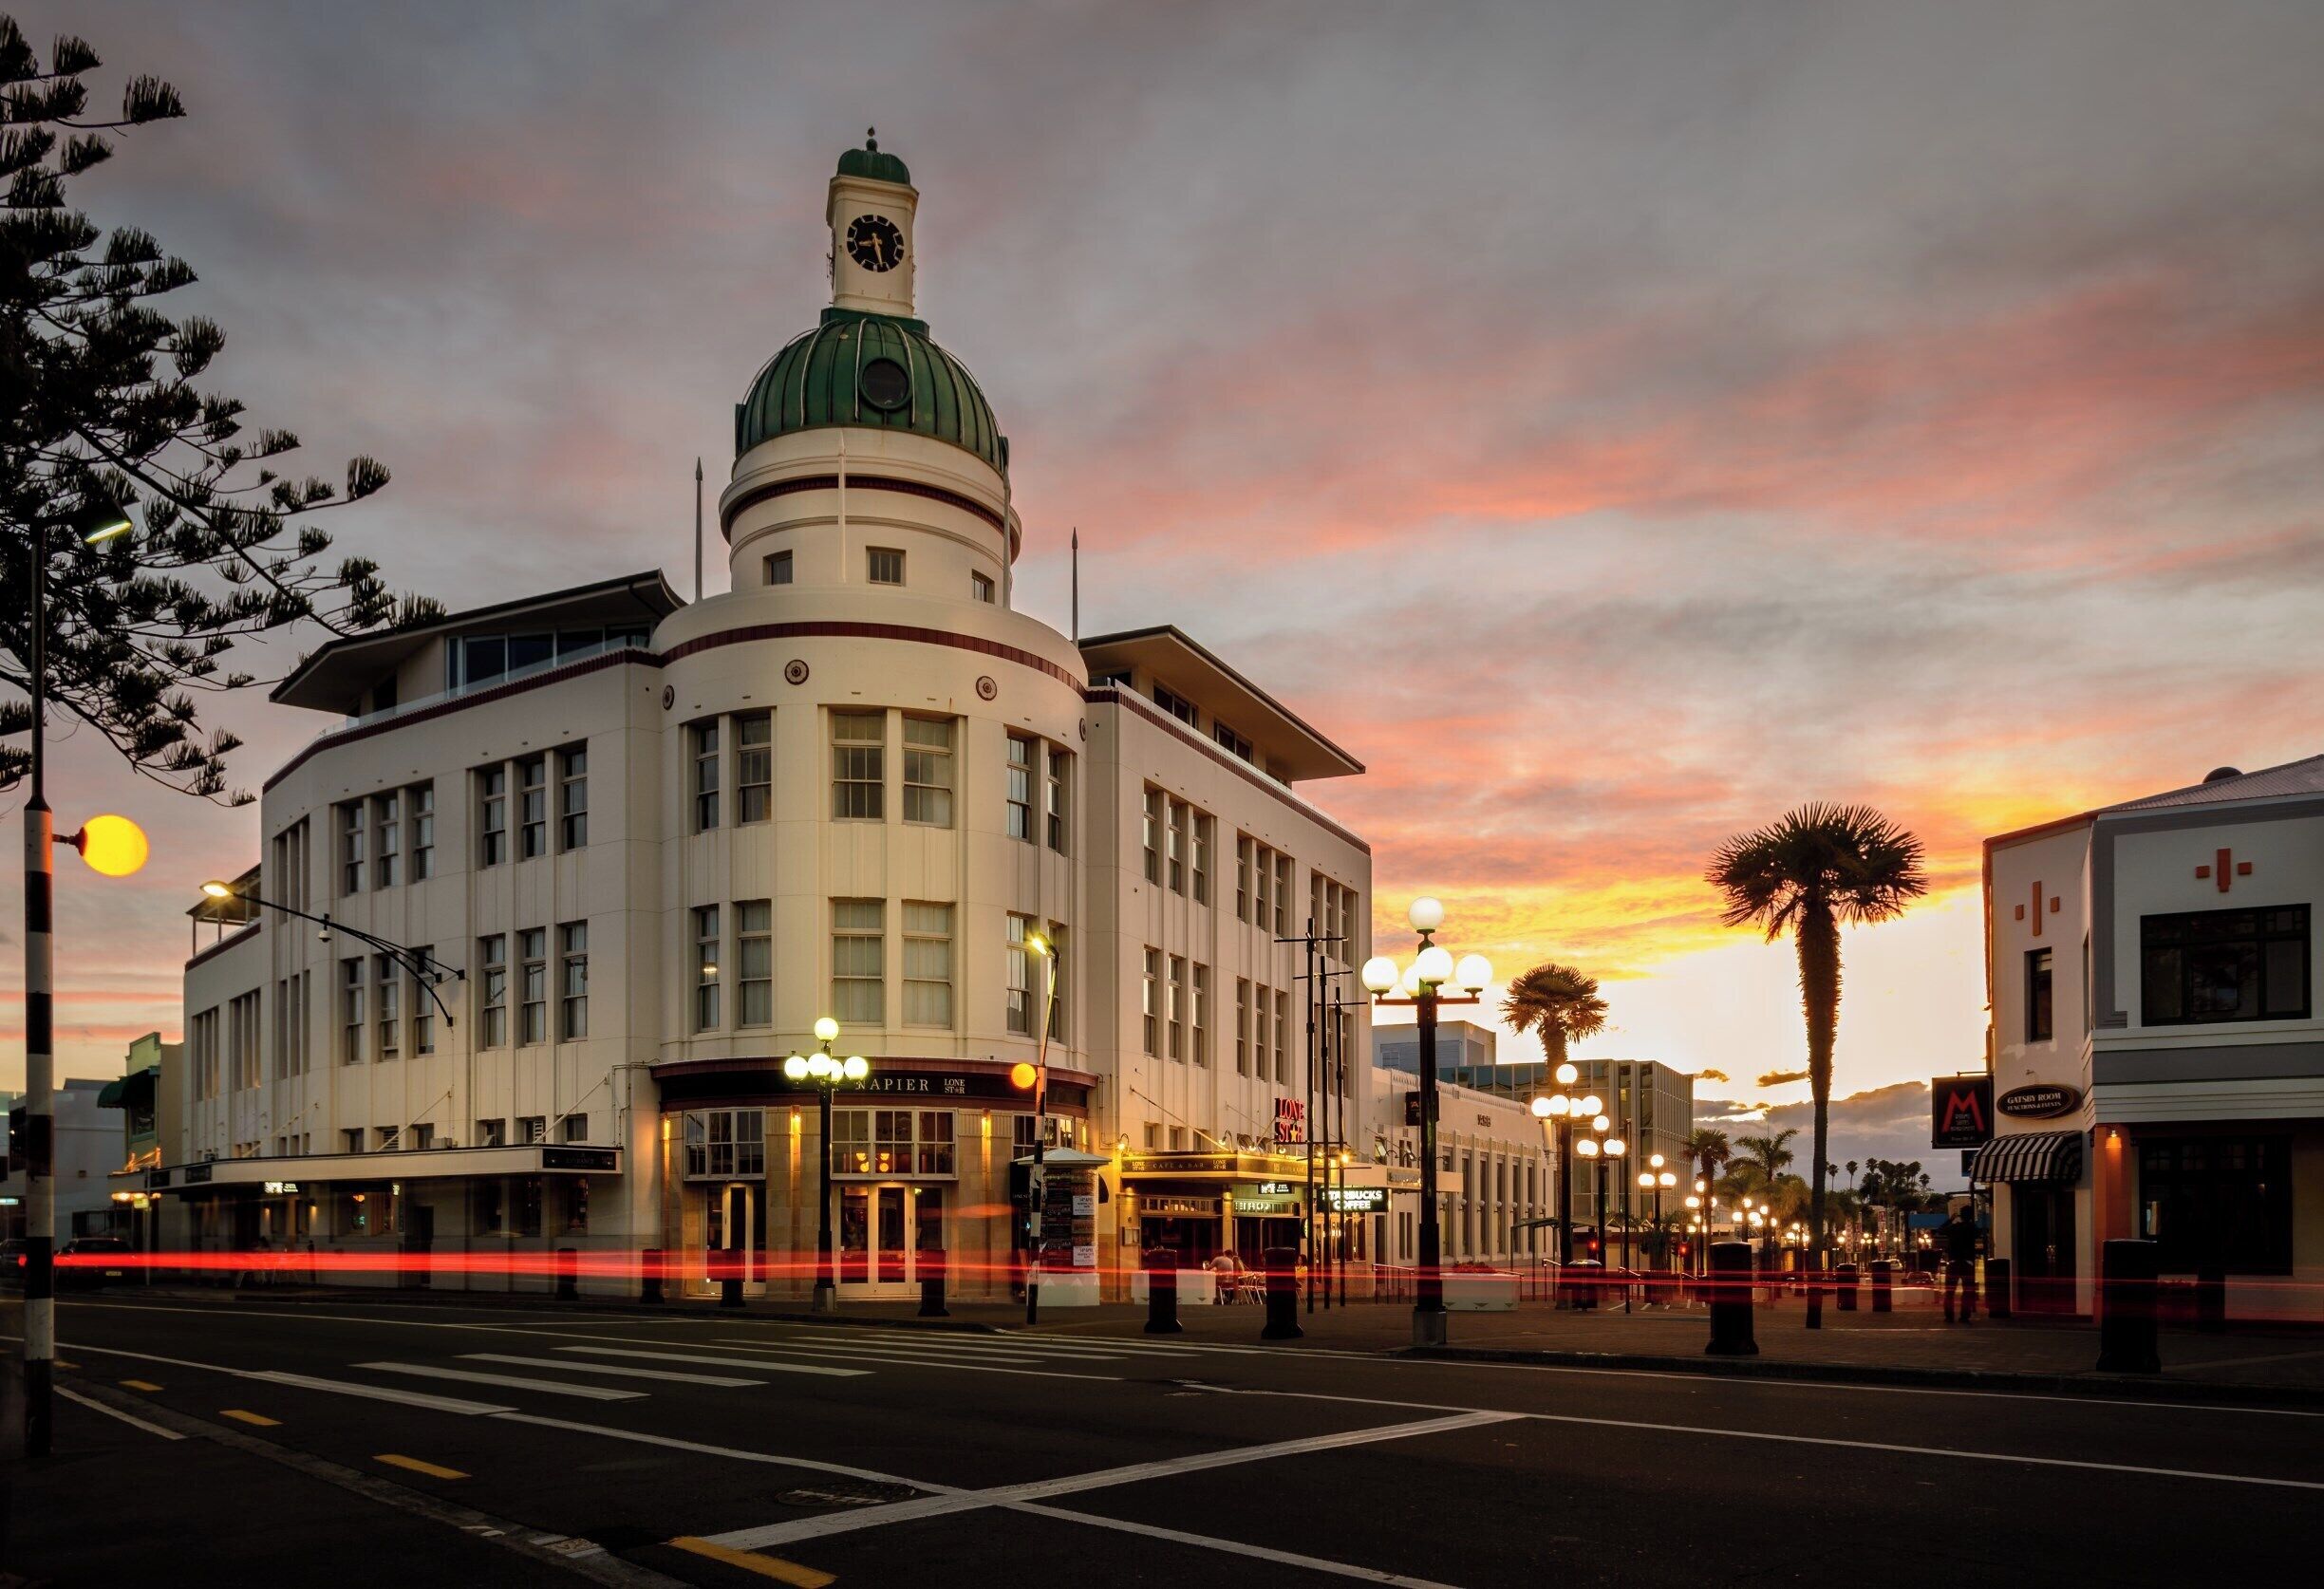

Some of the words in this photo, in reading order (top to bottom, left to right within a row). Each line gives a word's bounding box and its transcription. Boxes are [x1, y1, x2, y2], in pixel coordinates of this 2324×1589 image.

[855, 1078, 929, 1092] NAPIER
[944, 1078, 965, 1087] LONE
[2007, 1094, 2036, 1104] GATSBY
[2037, 1093, 2061, 1101] ROOM
[1279, 1097, 1304, 1121] LONE
[1940, 1087, 1985, 1133] M
